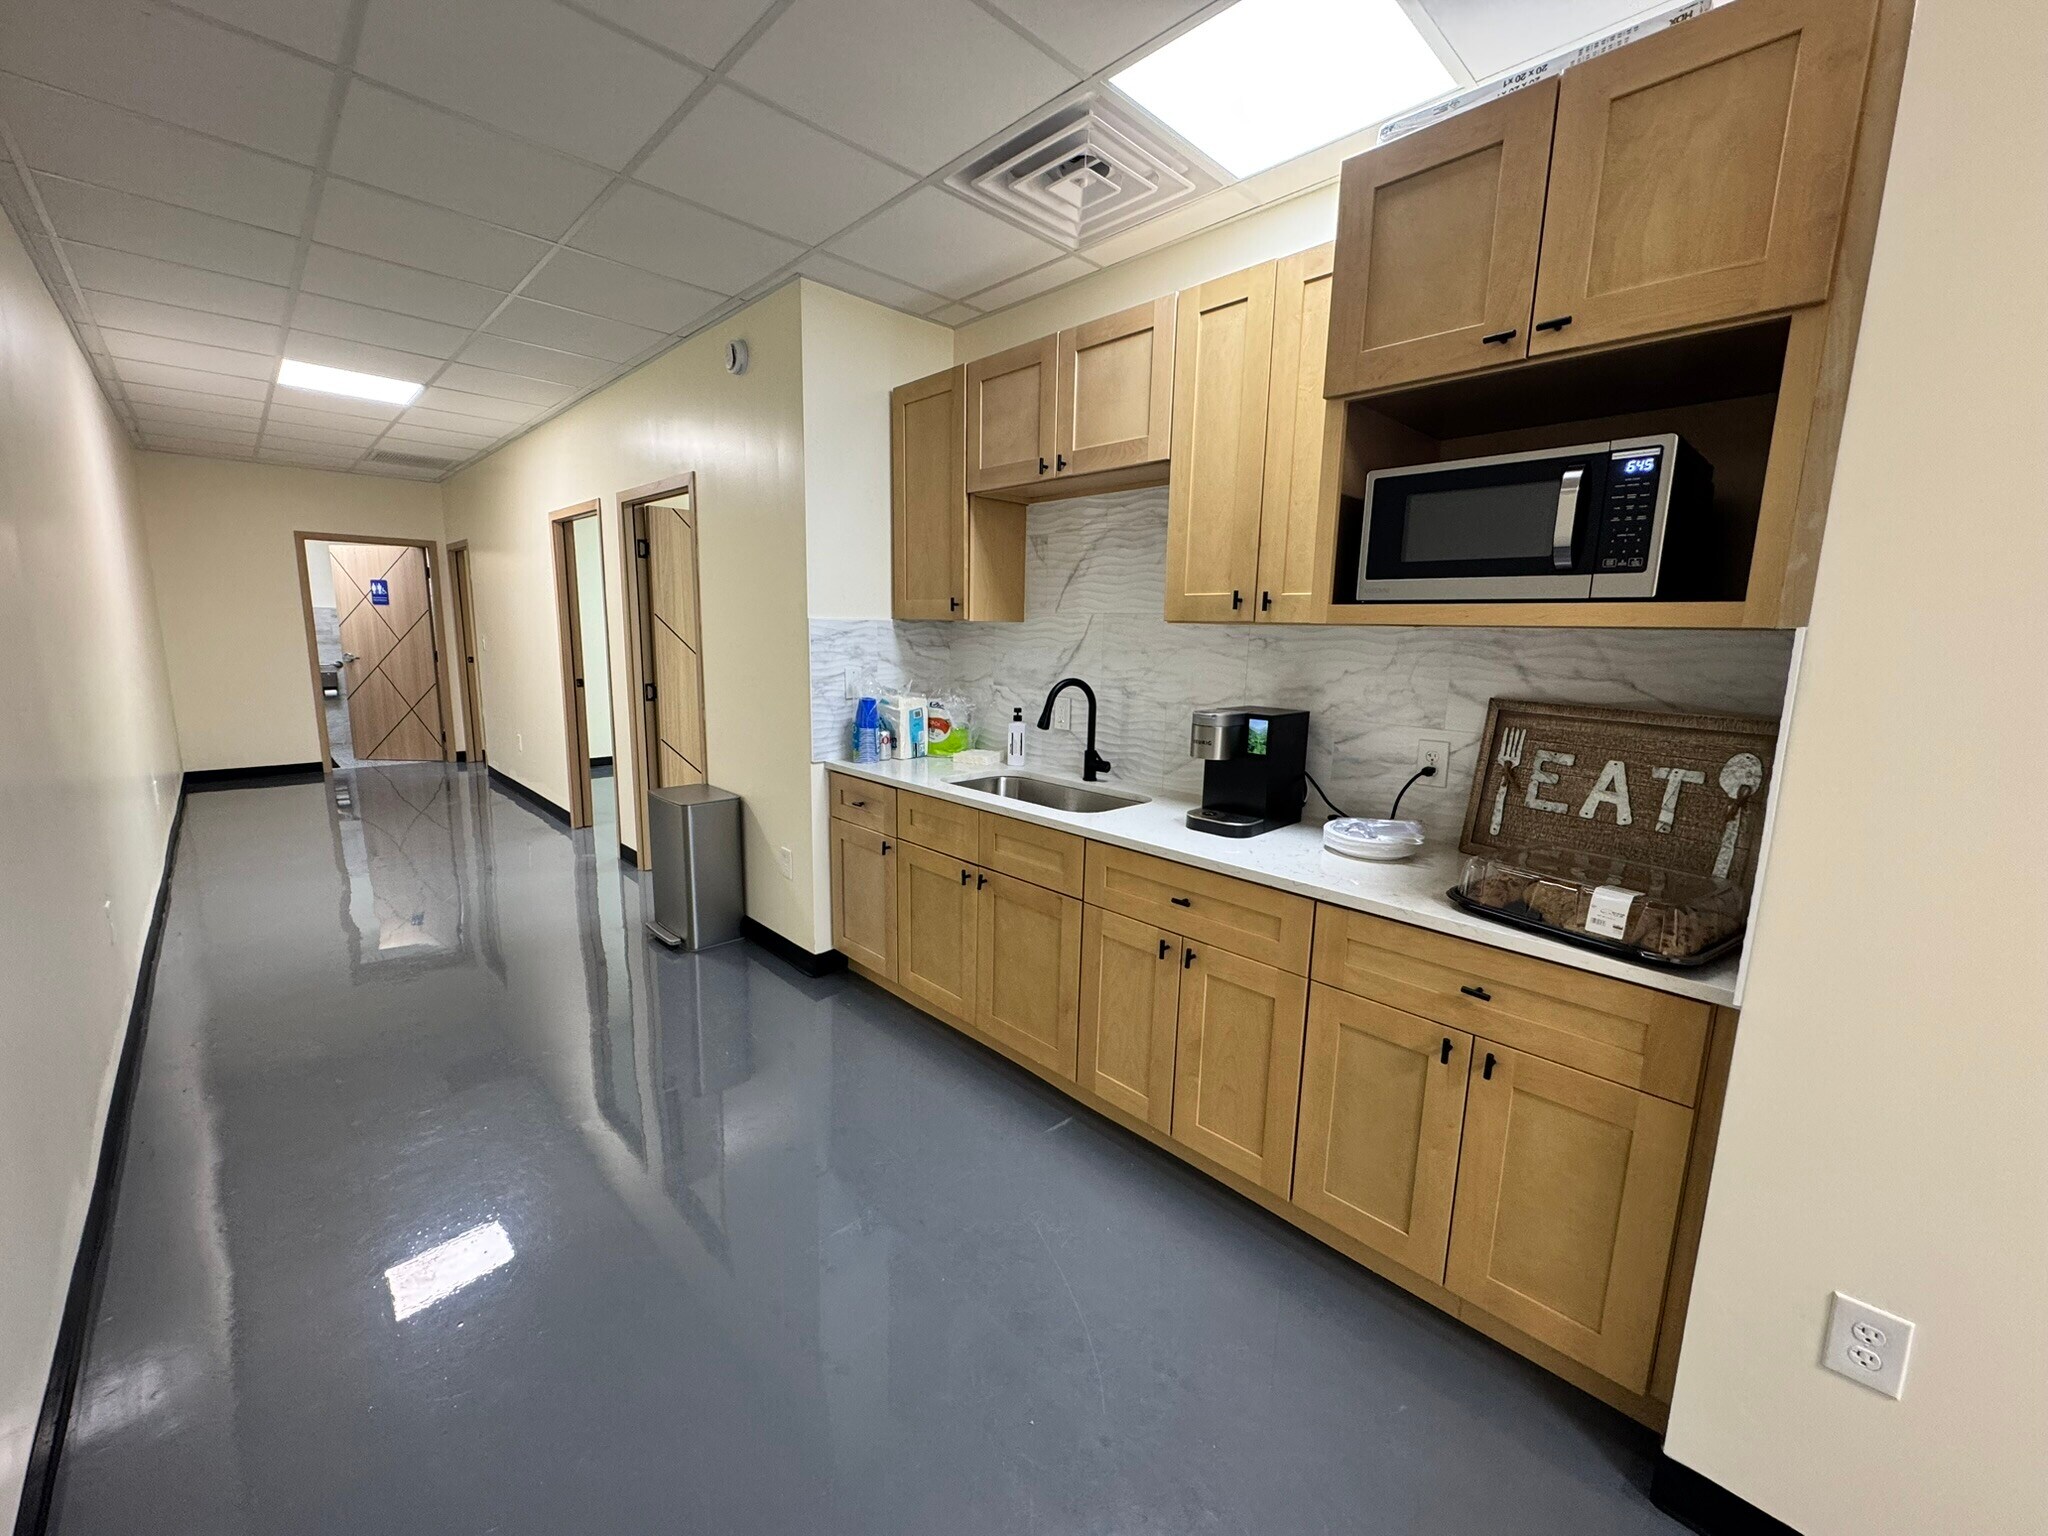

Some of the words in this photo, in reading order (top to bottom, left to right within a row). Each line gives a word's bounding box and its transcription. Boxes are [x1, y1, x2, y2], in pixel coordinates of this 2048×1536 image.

[1669, 10, 1693, 25] HDX
[1535, 63, 1548, 75] 20
[1514, 72, 1527, 83] 20
[1524, 749, 1706, 834] EAT
